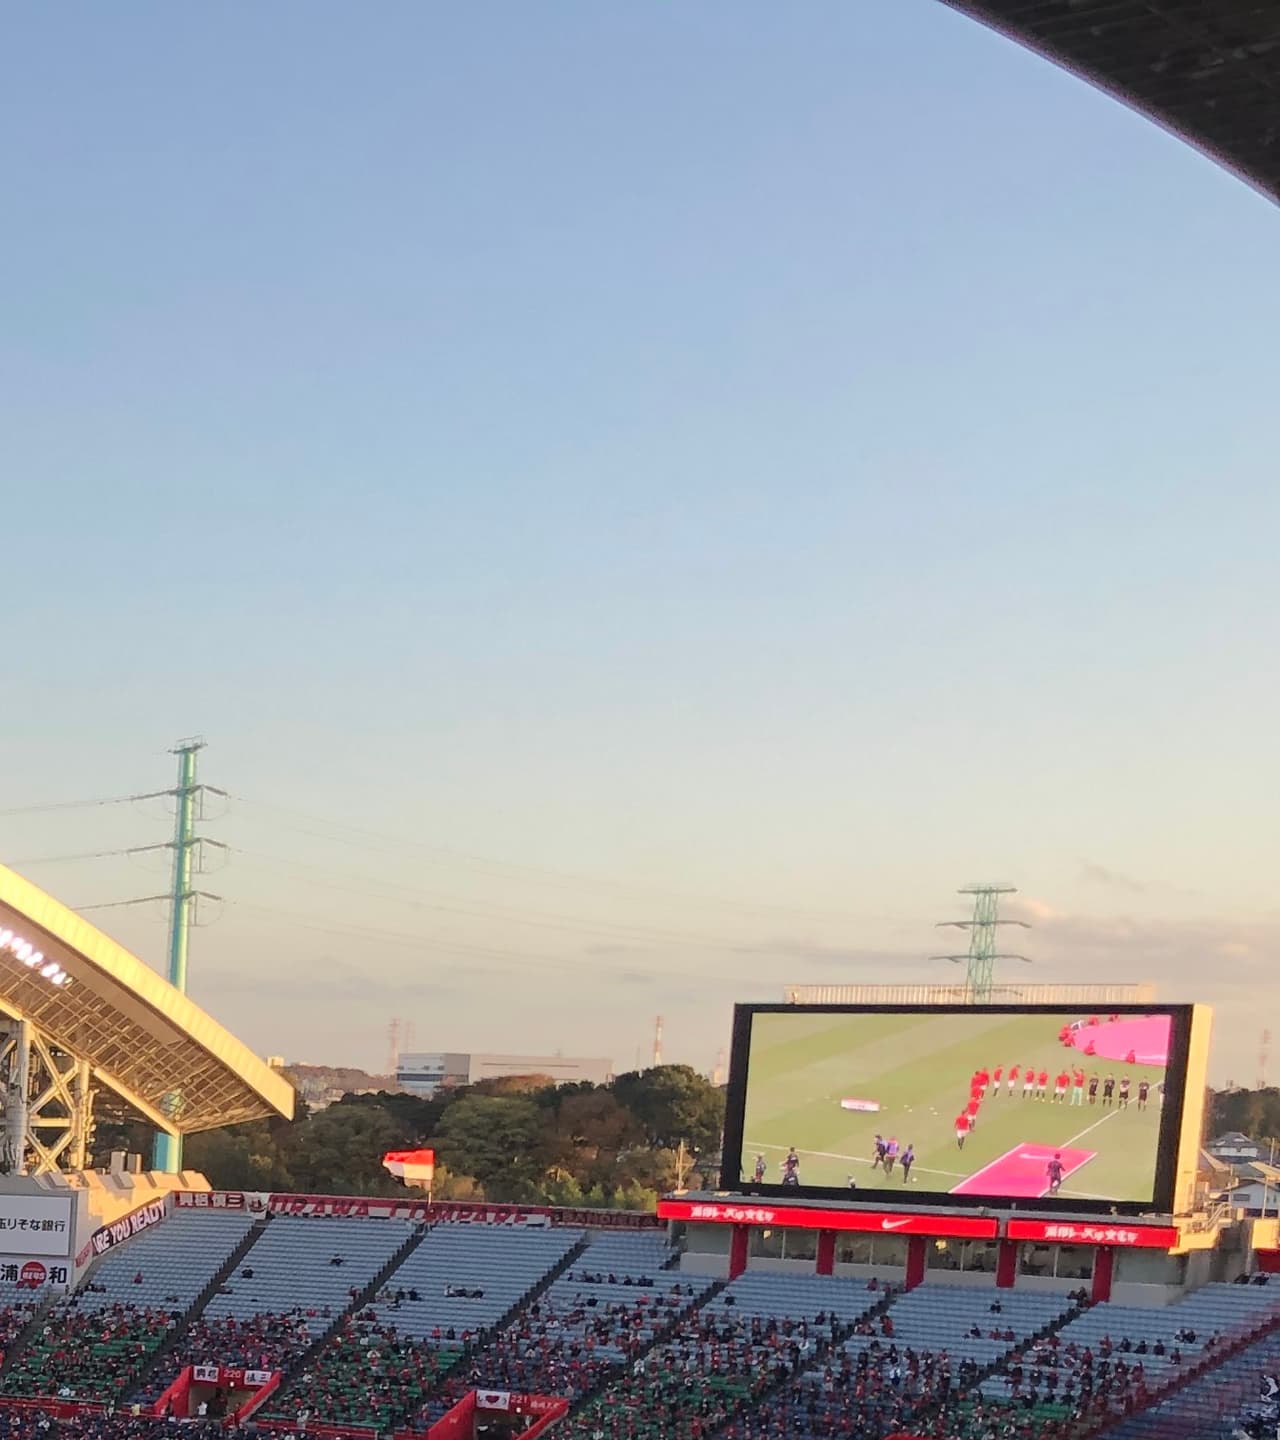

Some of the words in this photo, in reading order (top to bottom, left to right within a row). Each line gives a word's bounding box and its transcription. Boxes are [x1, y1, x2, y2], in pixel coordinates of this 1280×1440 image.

[110, 1218, 131, 1245] YOU
[131, 1200, 166, 1234] READY
[0, 1263, 18, 1282] 浦
[49, 1264, 67, 1284] 和
